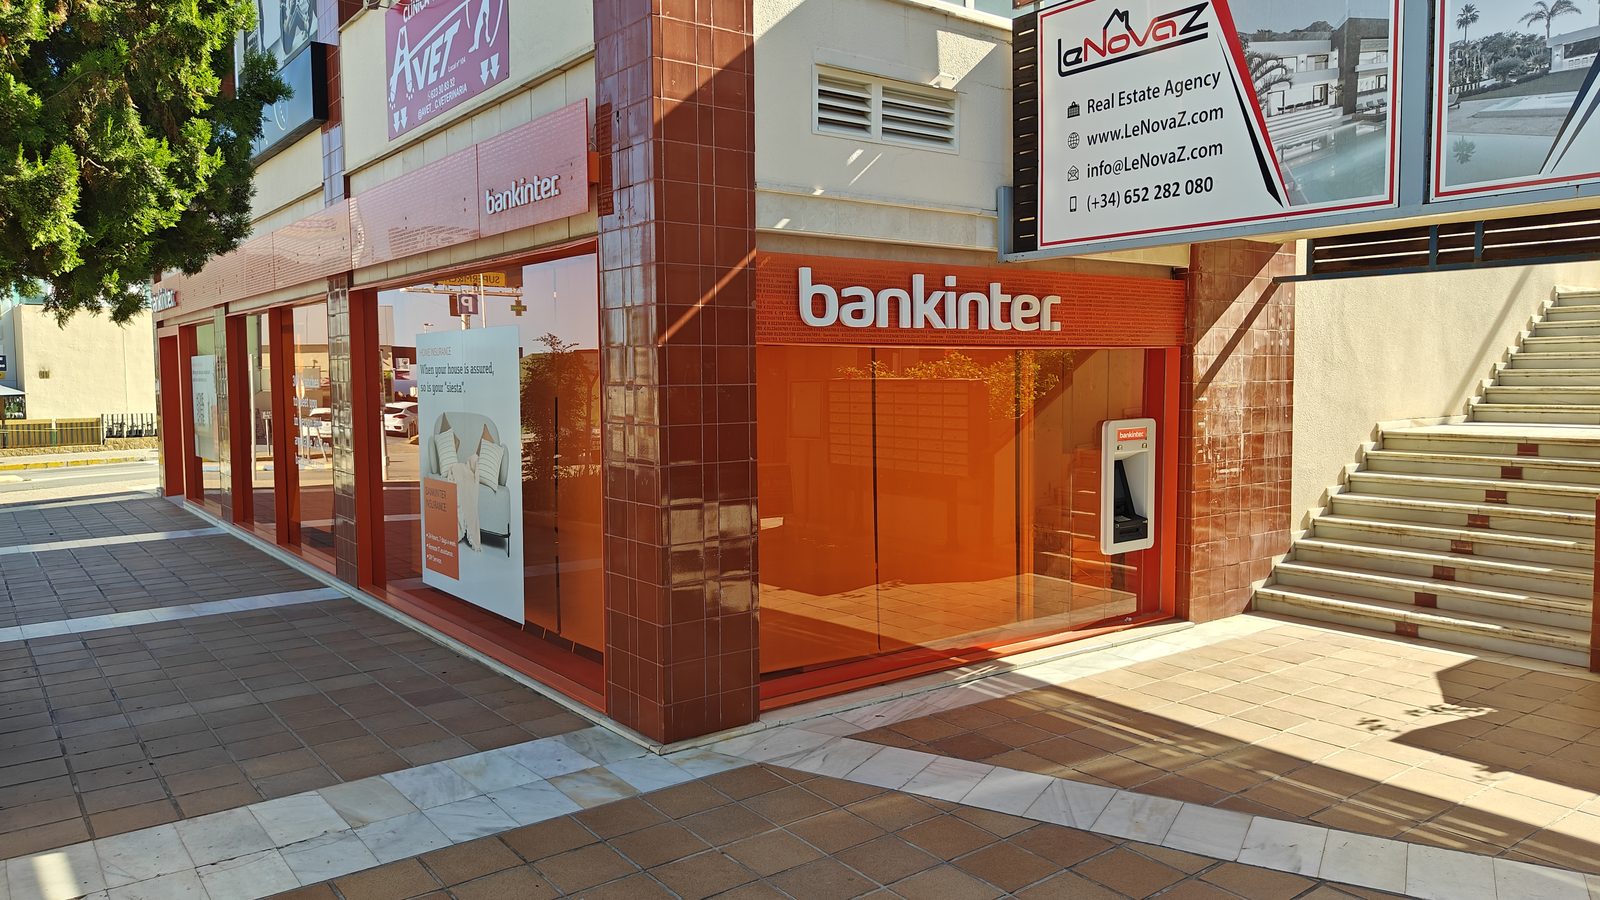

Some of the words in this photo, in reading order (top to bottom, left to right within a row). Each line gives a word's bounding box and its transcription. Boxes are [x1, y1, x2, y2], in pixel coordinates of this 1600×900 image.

[388, 18, 462, 102] AVET
[1087, 93, 1114, 113] Real
[1119, 85, 1160, 106] Estate
[1164, 71, 1221, 97] Agency
[1087, 106, 1223, 145] www.LeNovaZ.com
[1087, 142, 1223, 178] info@LeNovaZ.com
[1087, 190, 1120, 212] (+34)
[1124, 186, 1149, 204] 652
[1154, 182, 1180, 200] 282
[1185, 176, 1213, 195] 080
[420, 364, 434, 375] When
[435, 366, 447, 378] your
[447, 363, 463, 375] house
[464, 363, 469, 375] is
[470, 361, 495, 376] assured,
[420, 384, 426, 393] so
[427, 382, 431, 393] is
[432, 384, 444, 396] your
